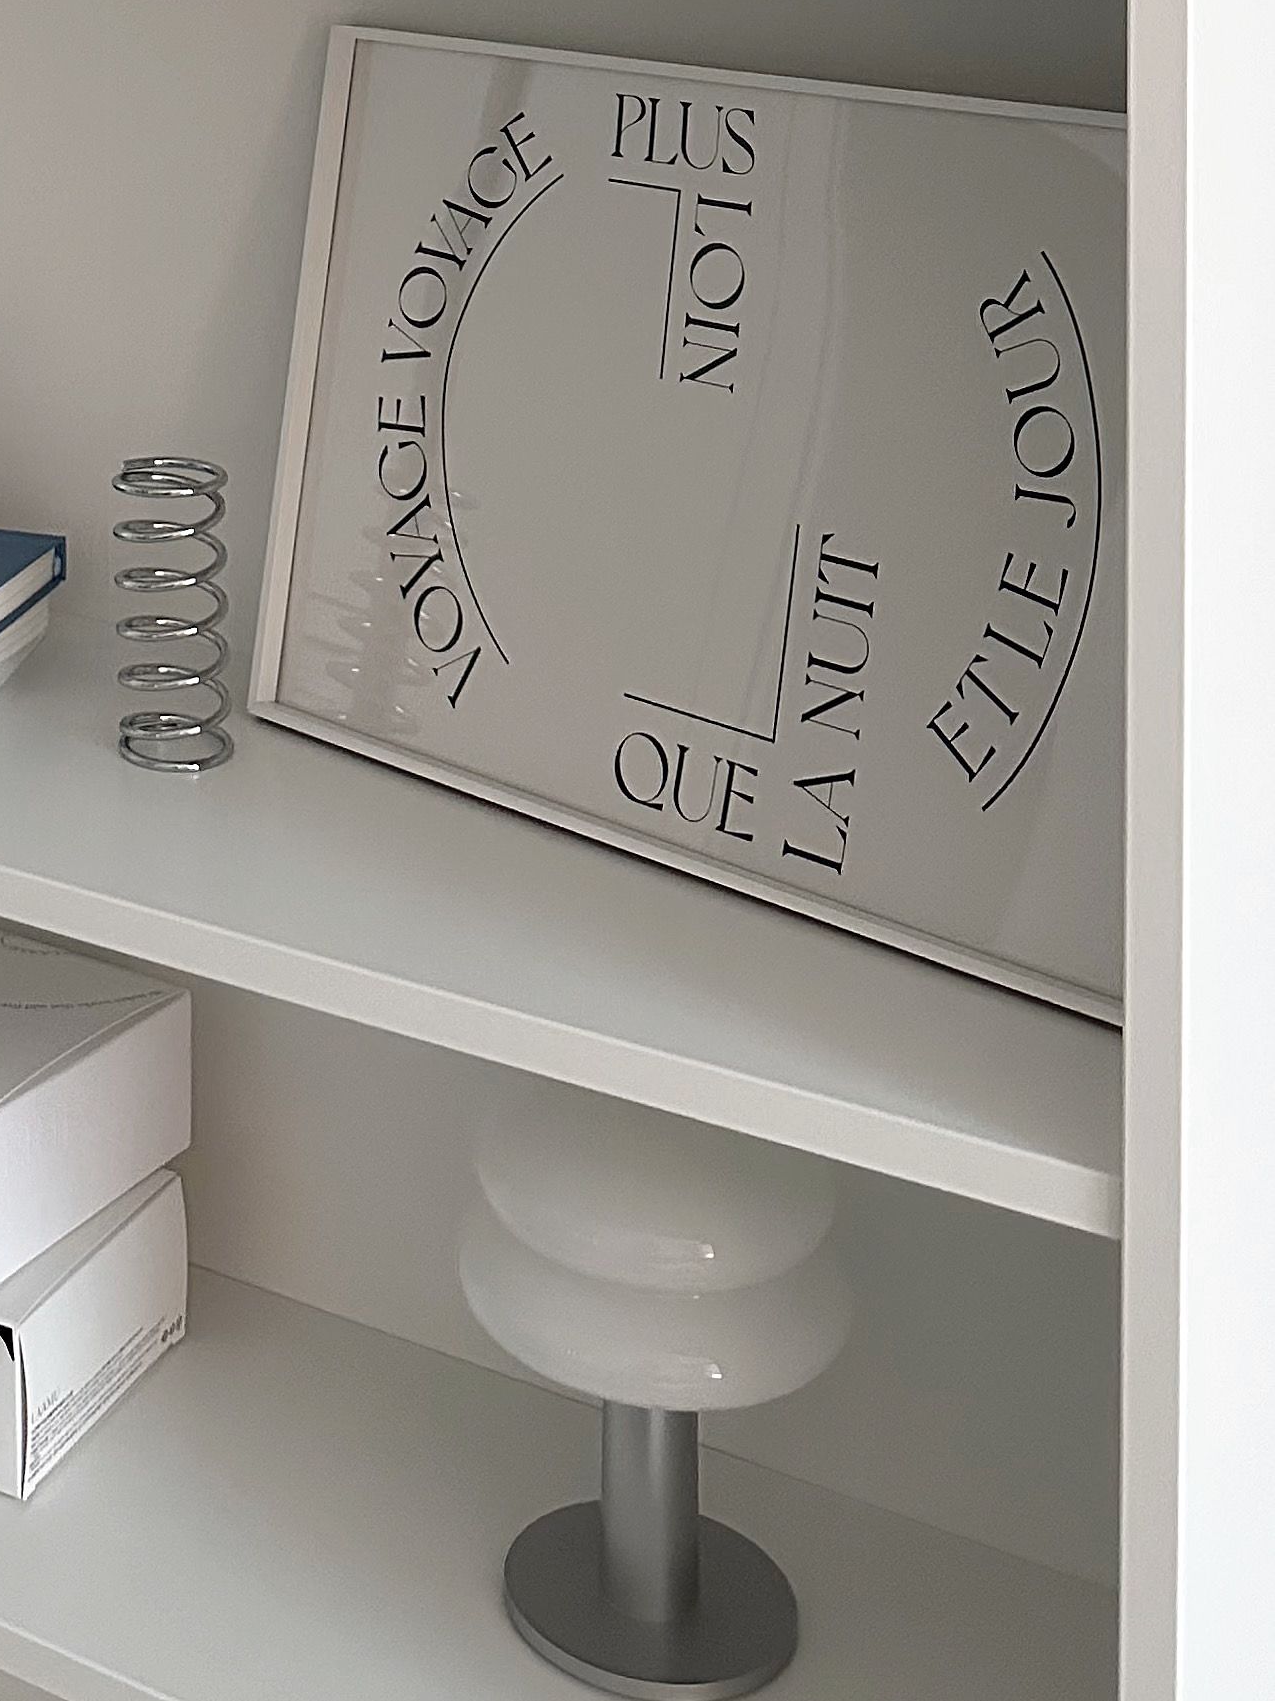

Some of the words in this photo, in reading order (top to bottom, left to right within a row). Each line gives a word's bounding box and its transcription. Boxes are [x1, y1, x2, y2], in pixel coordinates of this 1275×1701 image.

[609, 92, 756, 176] PLUS
[380, 111, 553, 365] VOYAGE
[679, 193, 753, 394] LOIN
[979, 269, 1077, 529] JOUR
[376, 395, 482, 709] VOYAGE
[799, 532, 880, 741] NUIT
[613, 729, 759, 842] QUE
[781, 767, 857, 876] LA
